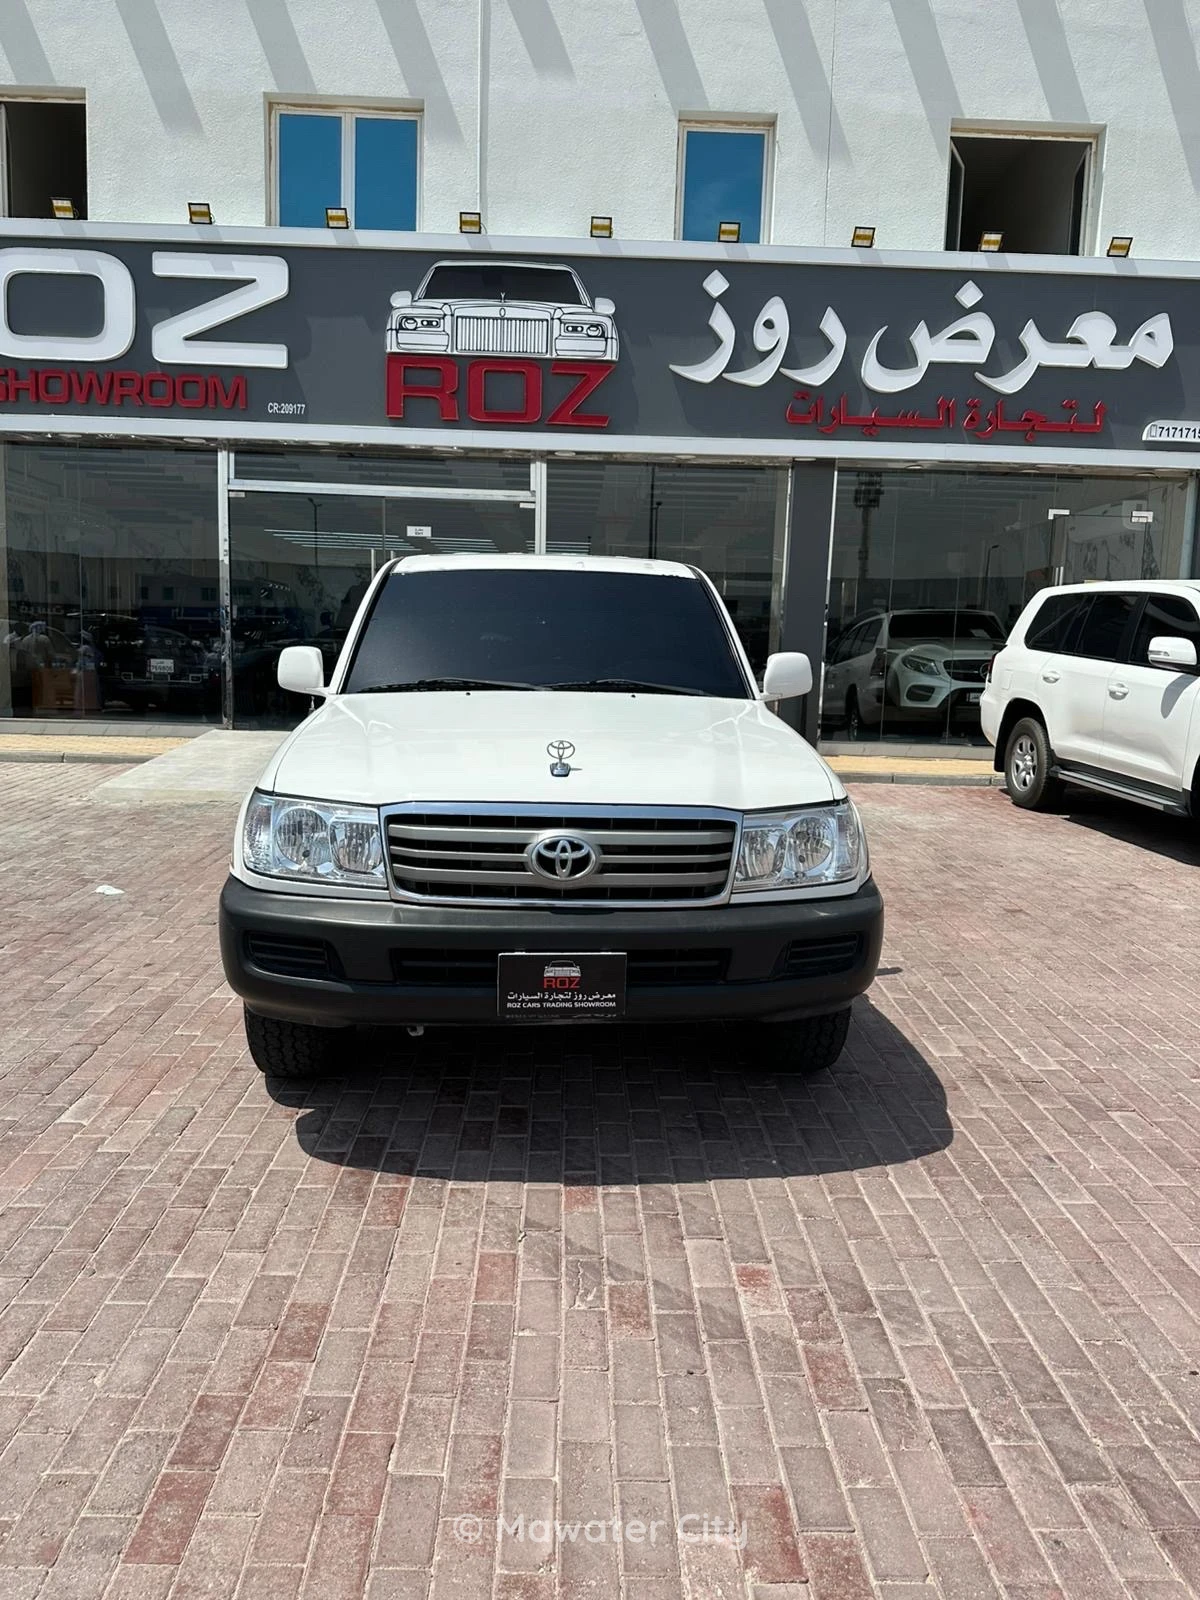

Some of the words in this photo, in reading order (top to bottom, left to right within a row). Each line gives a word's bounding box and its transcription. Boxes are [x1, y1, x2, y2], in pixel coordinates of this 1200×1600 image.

[669, 269, 847, 387] روز
[861, 280, 1174, 394] معرض
[386, 354, 616, 427] ROZ
[267, 402, 306, 414] CR:209177
[785, 390, 957, 436] السيارات
[963, 398, 1106, 442] لتجارة
[543, 977, 580, 989] ROZ
[507, 991, 543, 1001] السيارات
[544, 991, 572, 1001] لتجارة
[573, 991, 587, 1001] روز
[588, 991, 616, 1001] معرض
